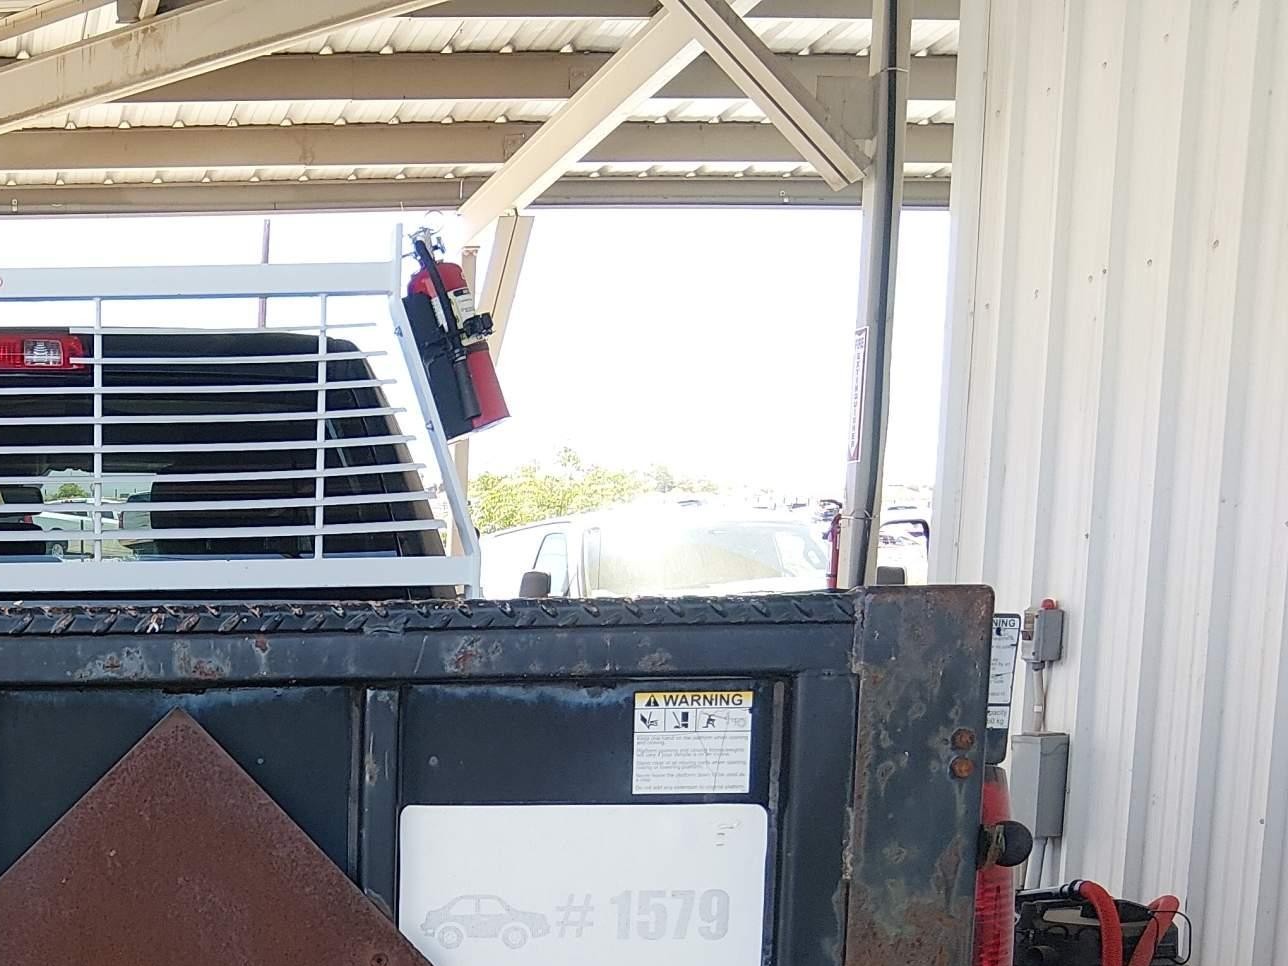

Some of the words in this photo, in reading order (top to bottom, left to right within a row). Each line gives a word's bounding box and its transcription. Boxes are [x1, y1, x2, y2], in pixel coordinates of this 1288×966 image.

[993, 618, 1016, 628] NING
[663, 693, 744, 707] WARNING
[555, 893, 595, 938] #
[609, 888, 731, 941] 1579
